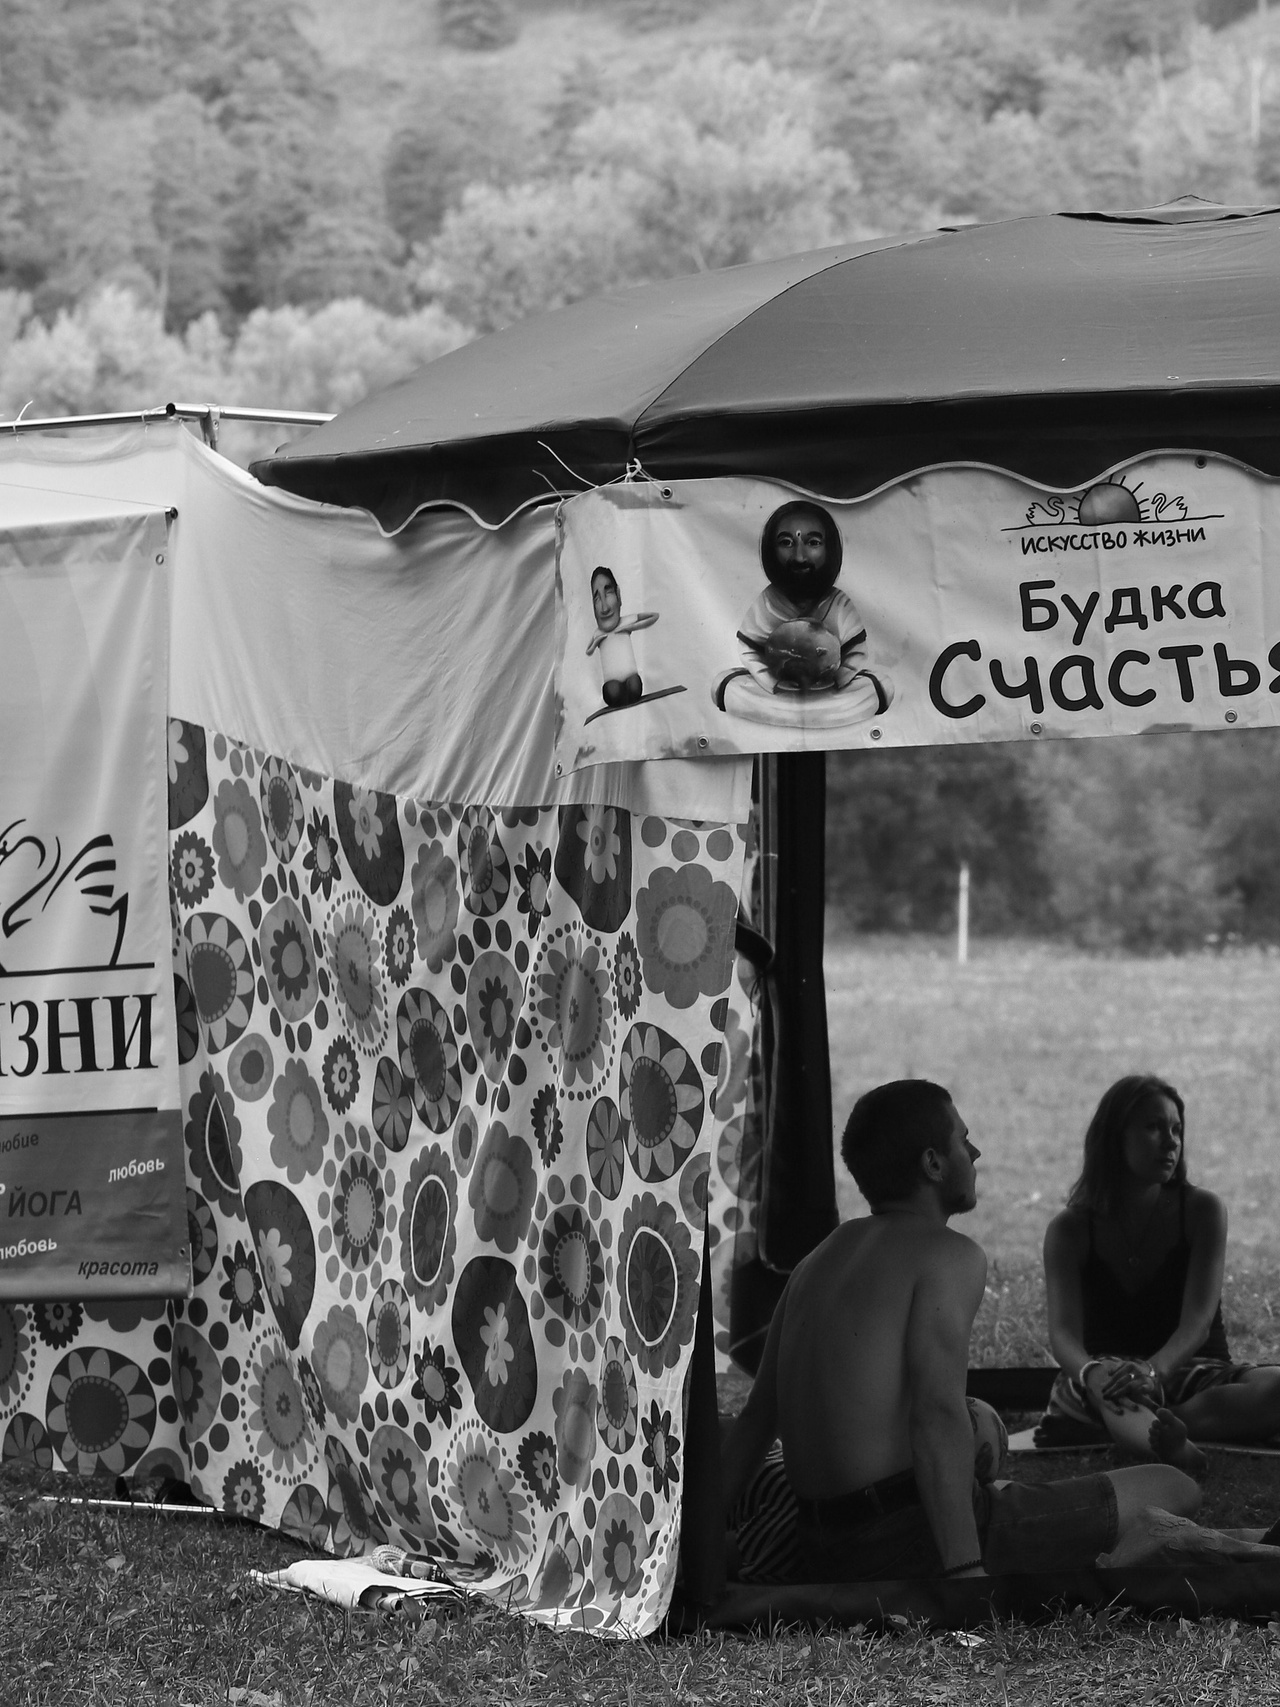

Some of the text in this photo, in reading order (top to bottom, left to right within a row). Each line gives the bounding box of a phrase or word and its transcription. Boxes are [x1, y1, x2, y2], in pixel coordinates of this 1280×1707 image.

[1020, 526, 1207, 555] ИСКУССТВО ЖИЗНИ
[1018, 579, 1227, 646] Будка
[0, 993, 158, 1078] ЗНИ
[0, 1132, 39, 1154] юбие
[108, 1157, 166, 1184] любовь
[8, 1185, 83, 1218] ЙОГА
[77, 1260, 160, 1280] красота
